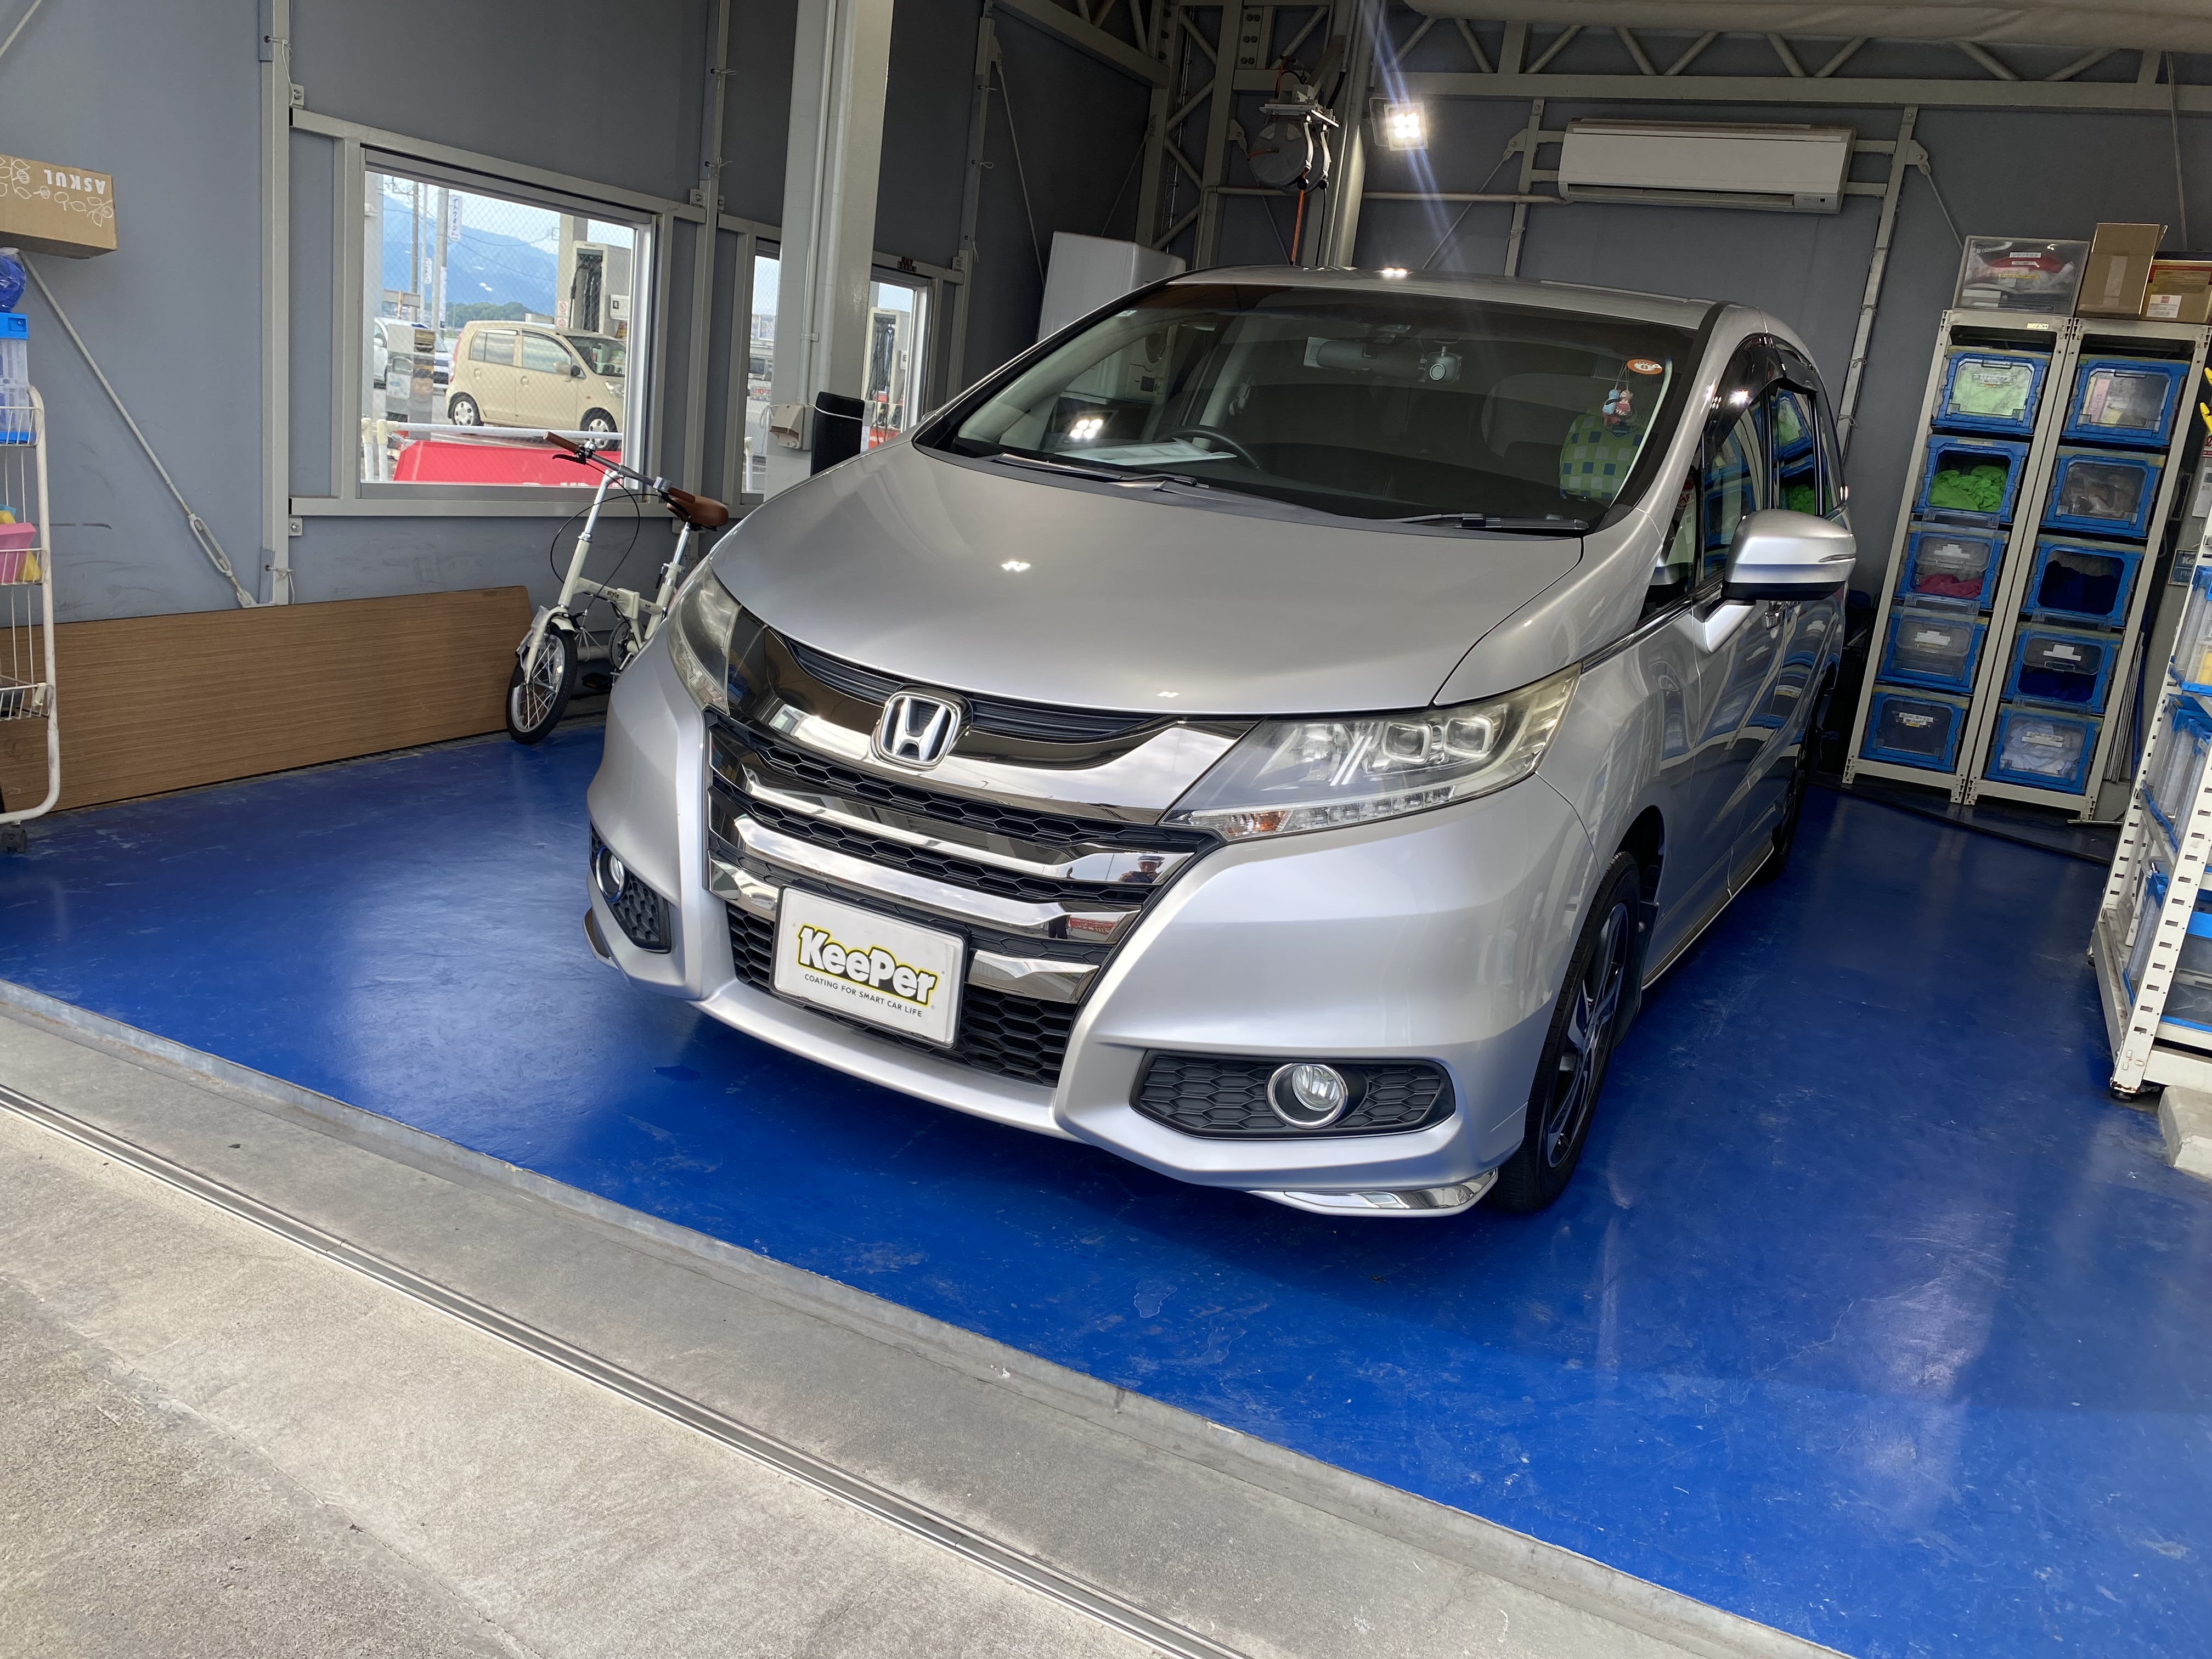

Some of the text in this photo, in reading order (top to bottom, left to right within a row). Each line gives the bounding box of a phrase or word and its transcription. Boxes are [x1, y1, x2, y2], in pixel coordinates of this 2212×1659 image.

[44, 169, 106, 194] ASKUL
[607, 590, 619, 599] style
[798, 924, 939, 1006] KeePer
[805, 974, 922, 1018] COATING FOR SMART CAR LIFE
